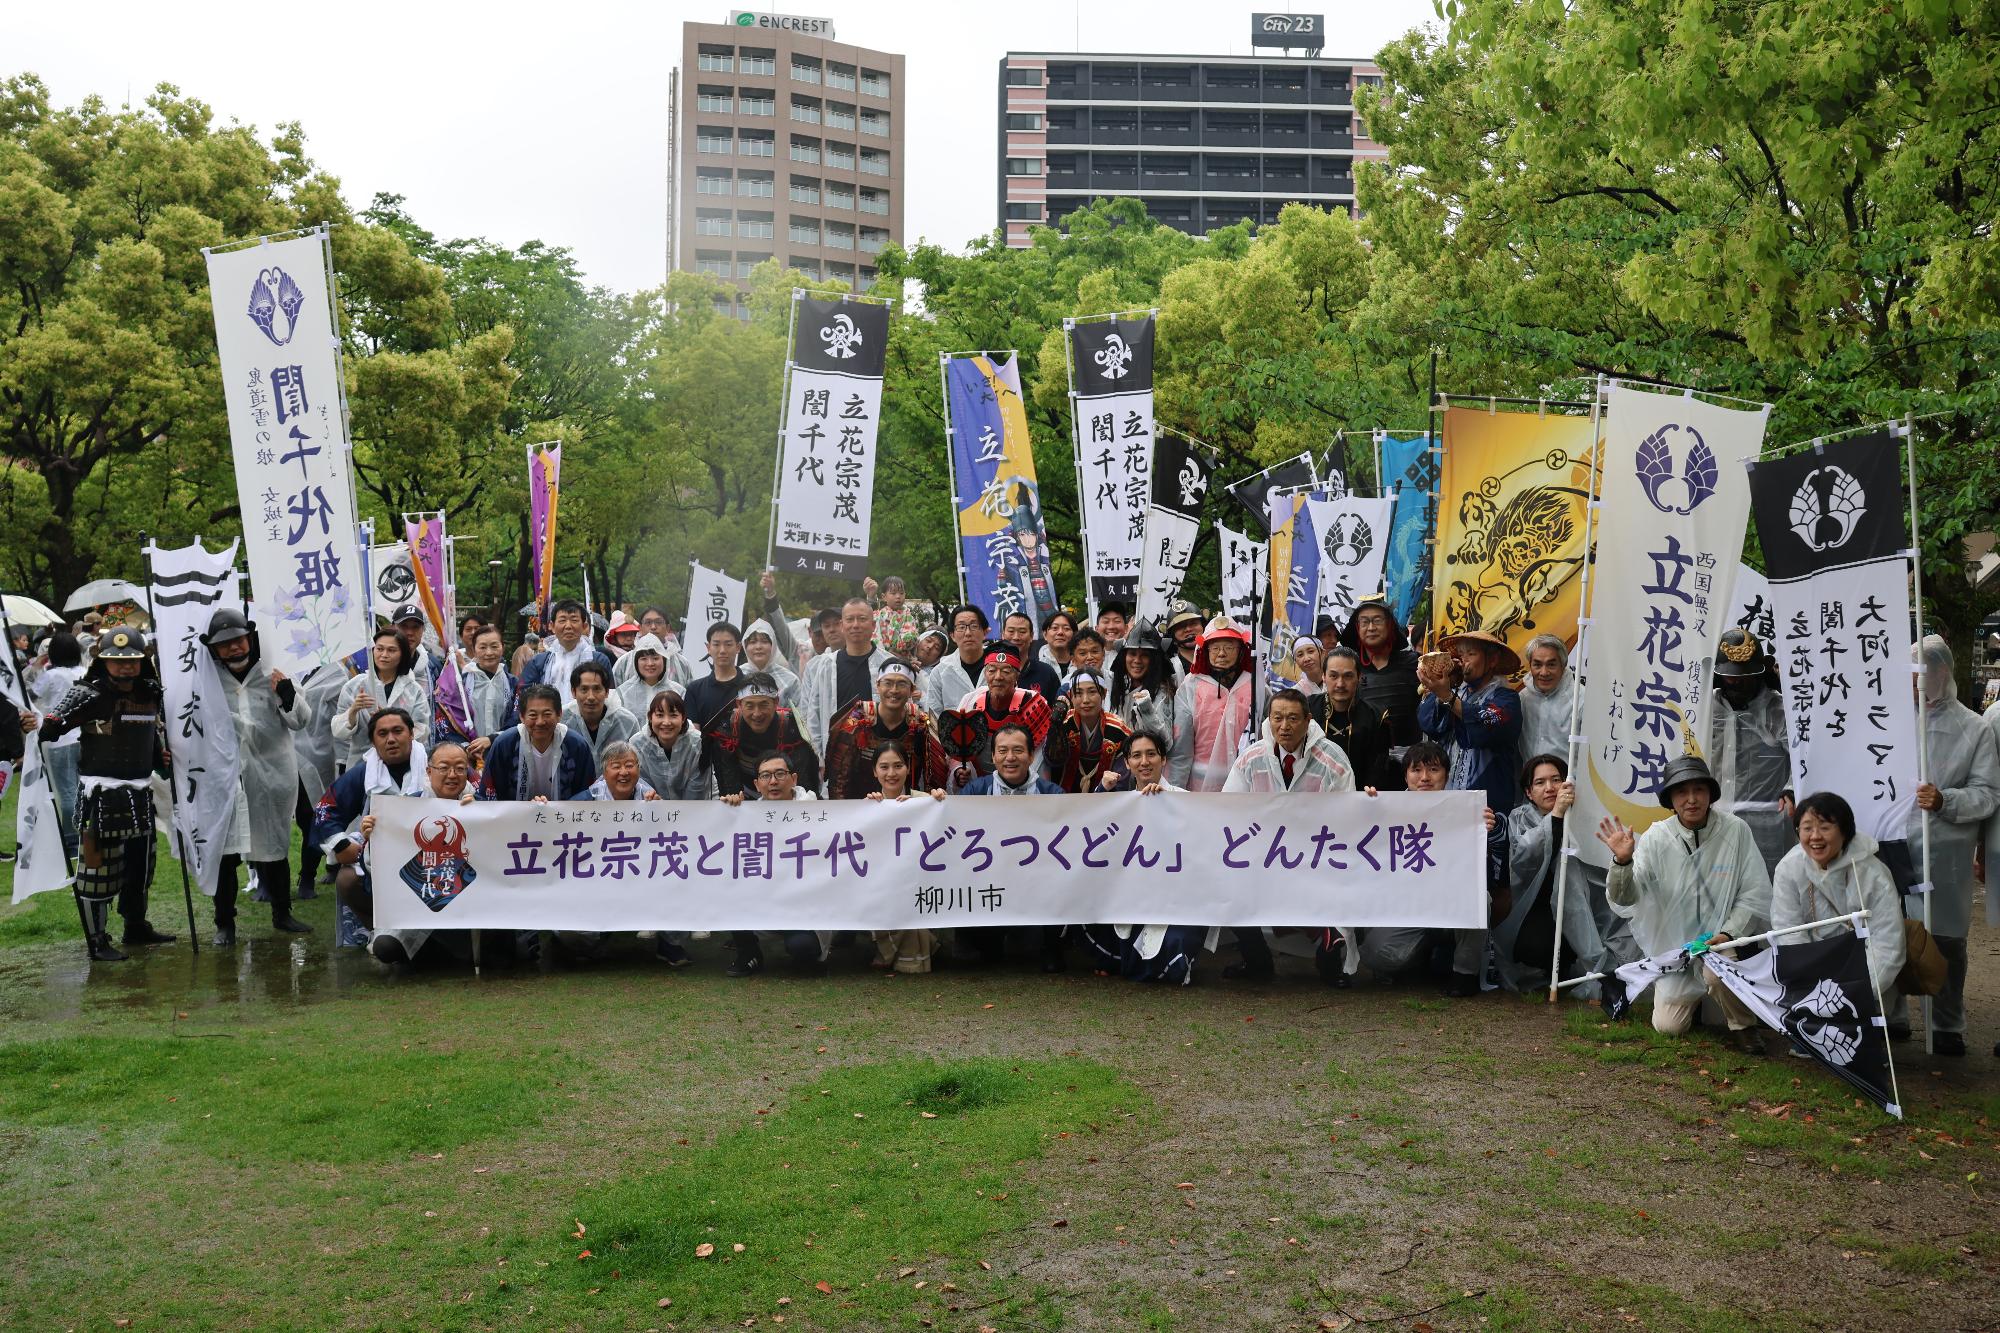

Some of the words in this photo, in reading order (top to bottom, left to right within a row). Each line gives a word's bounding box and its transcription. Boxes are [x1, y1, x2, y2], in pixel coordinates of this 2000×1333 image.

[1263, 18, 1292, 33] City
[1294, 16, 1314, 33] 23
[795, 388, 831, 486] 誾千代
[833, 393, 869, 524] 立花宗茂
[1091, 412, 1119, 511] 誾千代
[1121, 410, 1149, 541] 立花宗茂
[783, 529, 861, 549] 大河ドラマに
[785, 521, 802, 529] NHK
[975, 425, 1026, 621] 立花宗茂
[797, 557, 845, 573] 久山町
[1603, 678, 1625, 763] むねしげ
[1682, 659, 1703, 757] 復活の武
[535, 810, 602, 824] たちばな
[612, 809, 681, 823] むねしげ
[764, 809, 829, 823] ぎんちよ
[439, 851, 456, 896] 宗茂と
[914, 883, 1006, 914] 柳川市
